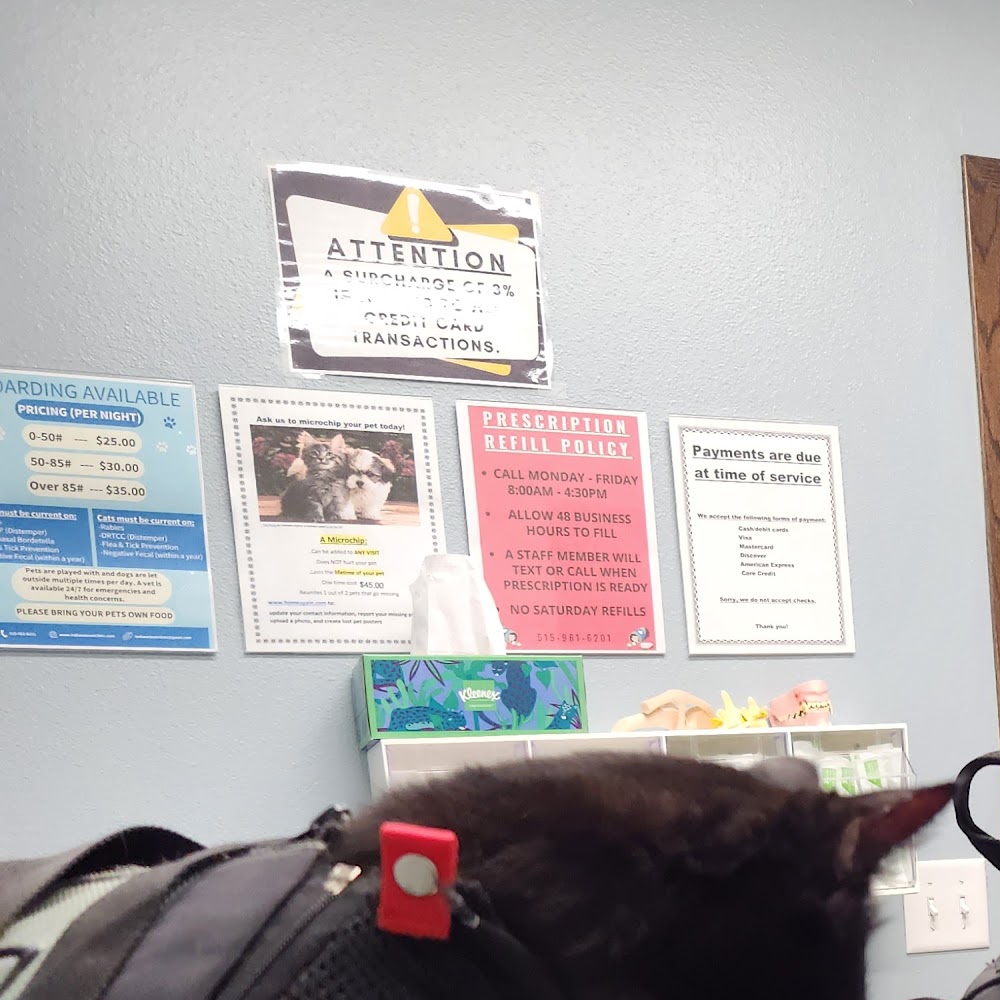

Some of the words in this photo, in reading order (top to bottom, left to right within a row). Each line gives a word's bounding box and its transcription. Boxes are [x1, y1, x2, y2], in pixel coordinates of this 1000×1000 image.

[328, 238, 506, 272] ATTENTION
[493, 284, 515, 297] 3%
[354, 331, 500, 354] TRANSACTIONS.
[0, 379, 77, 399] ARDING
[83, 386, 181, 407] AVAILABLE
[18, 404, 67, 417] PRICING
[70, 407, 97, 420] (PER
[100, 410, 142, 424] NIGHT)
[299, 419, 341, 427] microchip
[380, 423, 405, 431] today!
[482, 411, 626, 434] PRESCRIPTION
[29, 431, 62, 442] 0-50#
[96, 435, 136, 447] $25.00
[484, 434, 550, 453] REFILL
[561, 438, 628, 457] POLICY
[692, 445, 765, 460] Payments
[769, 451, 792, 462] are
[796, 451, 821, 463] due
[30, 457, 71, 468] 50-85#
[100, 461, 139, 473] $30.00
[494, 468, 524, 480] CALL
[529, 470, 585, 483] MONDAY
[596, 474, 638, 486] FRIDAY
[695, 468, 709, 479] at
[714, 468, 747, 481] time
[752, 470, 765, 482] of
[770, 471, 821, 484] service
[30, 481, 59, 492] Over
[62, 482, 84, 492] 85#
[106, 485, 145, 497] $35.00
[508, 485, 553, 497] 8:00AM
[564, 487, 607, 499] 4:30PM
[508, 510, 553, 521] ALLOW
[557, 511, 571, 522] 48
[575, 512, 632, 524] BUSINESS
[527, 526, 570, 537] HOURS
[573, 527, 590, 537] TO
[594, 529, 617, 539] FILL
[505, 550, 514, 560] A
[517, 550, 553, 561] STAFF
[557, 551, 609, 562] MEMBER
[612, 553, 641, 563] WILL
[512, 565, 542, 576] TEXT
[546, 566, 564, 576] OR
[568, 567, 597, 577] CALL
[599, 568, 637, 578] WHEN
[504, 581, 592, 592] PRESCRIPTION
[596, 582, 606, 592] IS
[610, 583, 647, 593] READY
[510, 605, 530, 615] NO
[534, 605, 598, 616] SATURDAY
[602, 606, 646, 617] REFILLS
[459, 687, 500, 702] Kleenex
